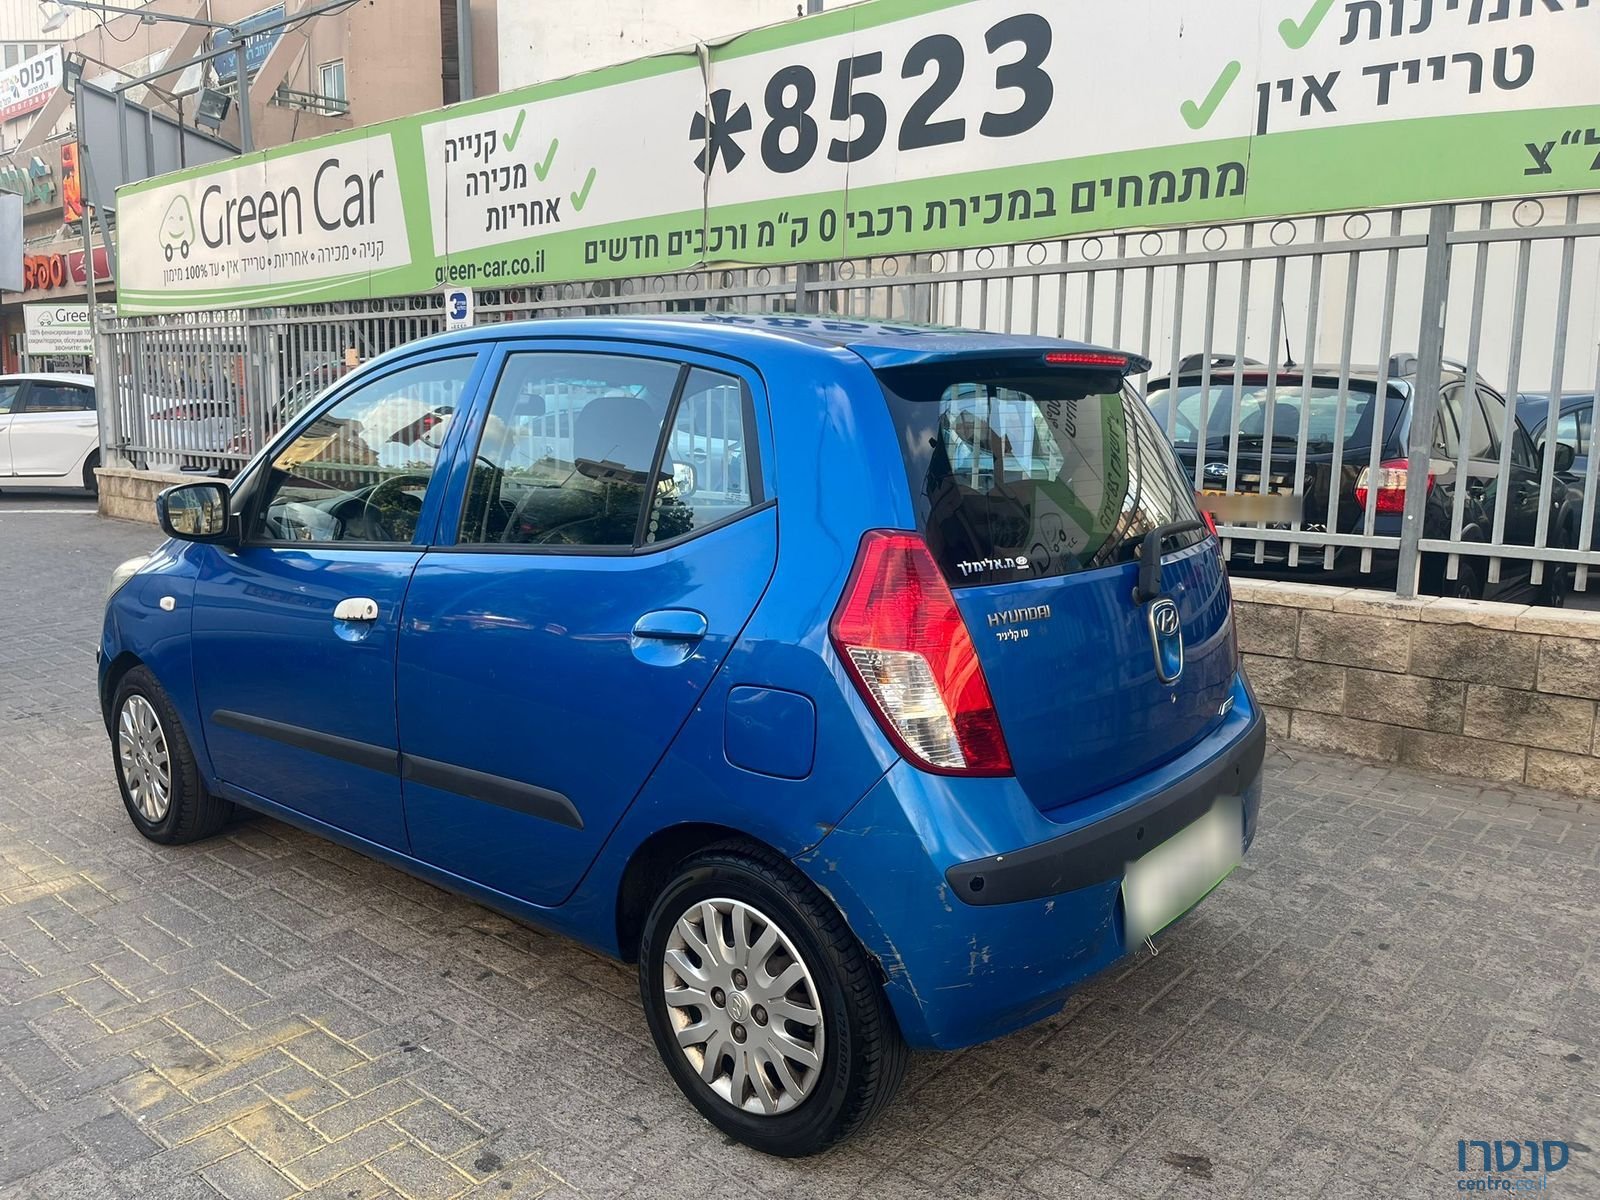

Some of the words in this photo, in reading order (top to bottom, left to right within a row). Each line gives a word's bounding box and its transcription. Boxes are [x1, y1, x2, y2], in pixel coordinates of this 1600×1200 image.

[19, 55, 54, 88] דפוס
[1362, 44, 1535, 106] טרייד
[1256, 71, 1342, 135] אין
[445, 130, 497, 163] קנייה
[466, 163, 527, 197] מכירה
[1071, 161, 1245, 214] מתמחים
[200, 184, 303, 249] Green
[313, 158, 385, 232] Car
[486, 197, 561, 232] אחריות
[922, 186, 1057, 230] במכירת
[819, 207, 836, 242] 0
[845, 204, 912, 239] רכבי
[318, 244, 349, 263] מכירה
[360, 240, 384, 261] קניה
[585, 232, 658, 264] חדשים
[668, 222, 747, 256] ורכבים
[185, 264, 208, 280] 100%
[209, 262, 220, 277] עד
[226, 260, 239, 279] אין
[241, 256, 266, 273] טרייד
[274, 250, 309, 269] אחריות
[435, 249, 545, 285] green-car.co.il
[163, 268, 183, 287] מימון
[987, 604, 1051, 627] HYUNDAI
